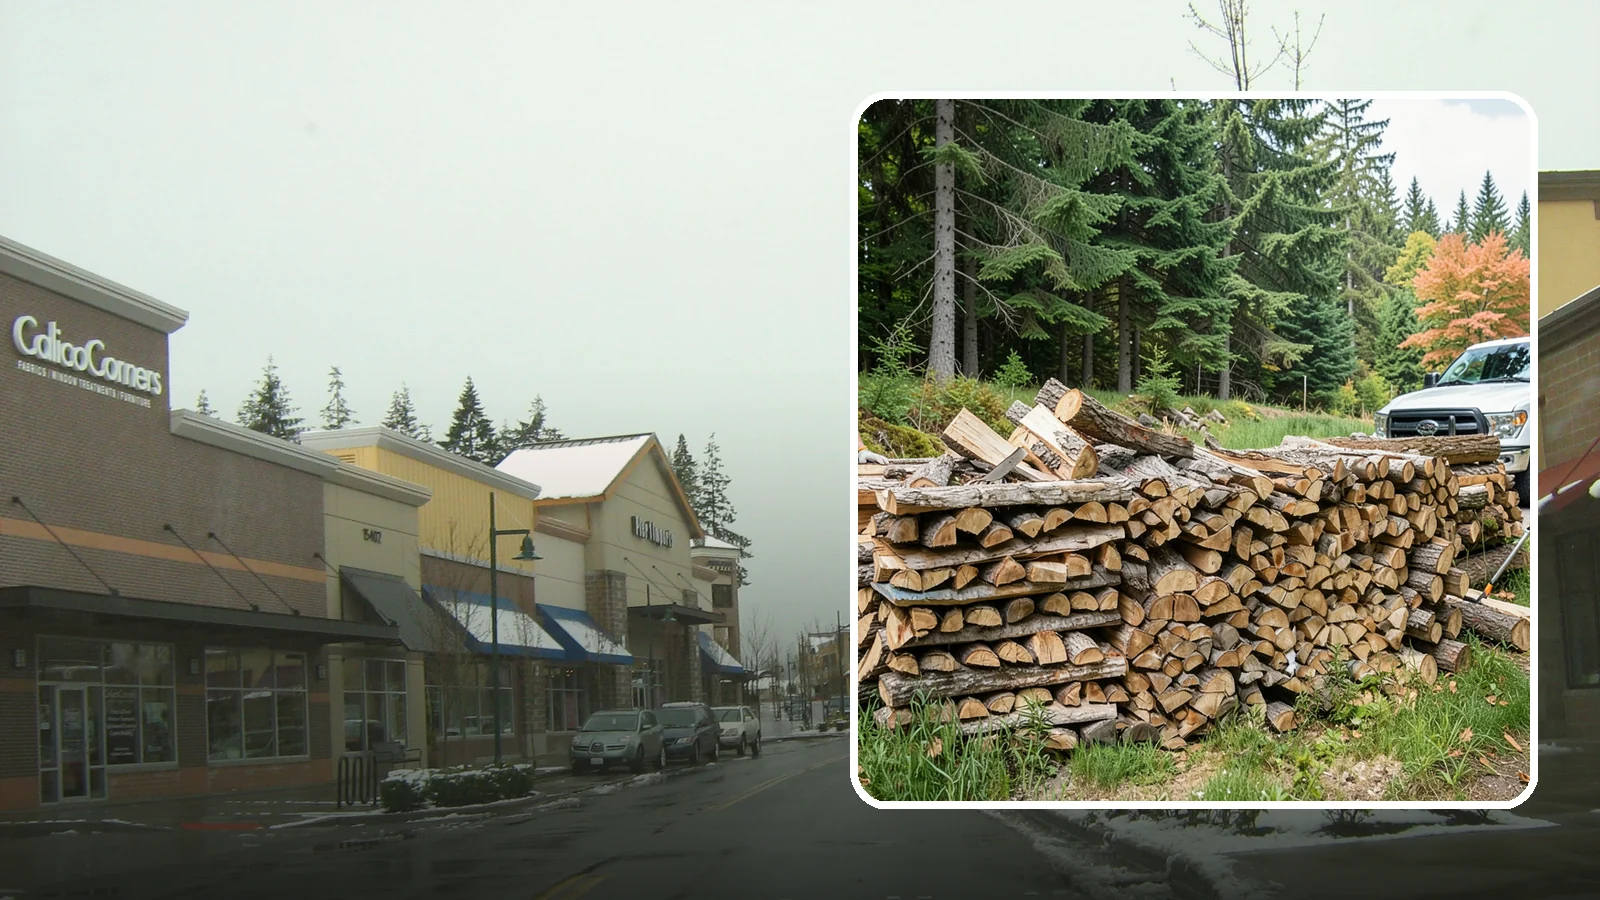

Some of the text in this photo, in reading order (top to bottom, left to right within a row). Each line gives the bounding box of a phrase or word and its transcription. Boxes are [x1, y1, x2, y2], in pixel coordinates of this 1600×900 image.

[17, 360, 47, 377] FABRICS
[52, 371, 78, 386] WINDOW
[78, 378, 117, 398] TREATMENTS
